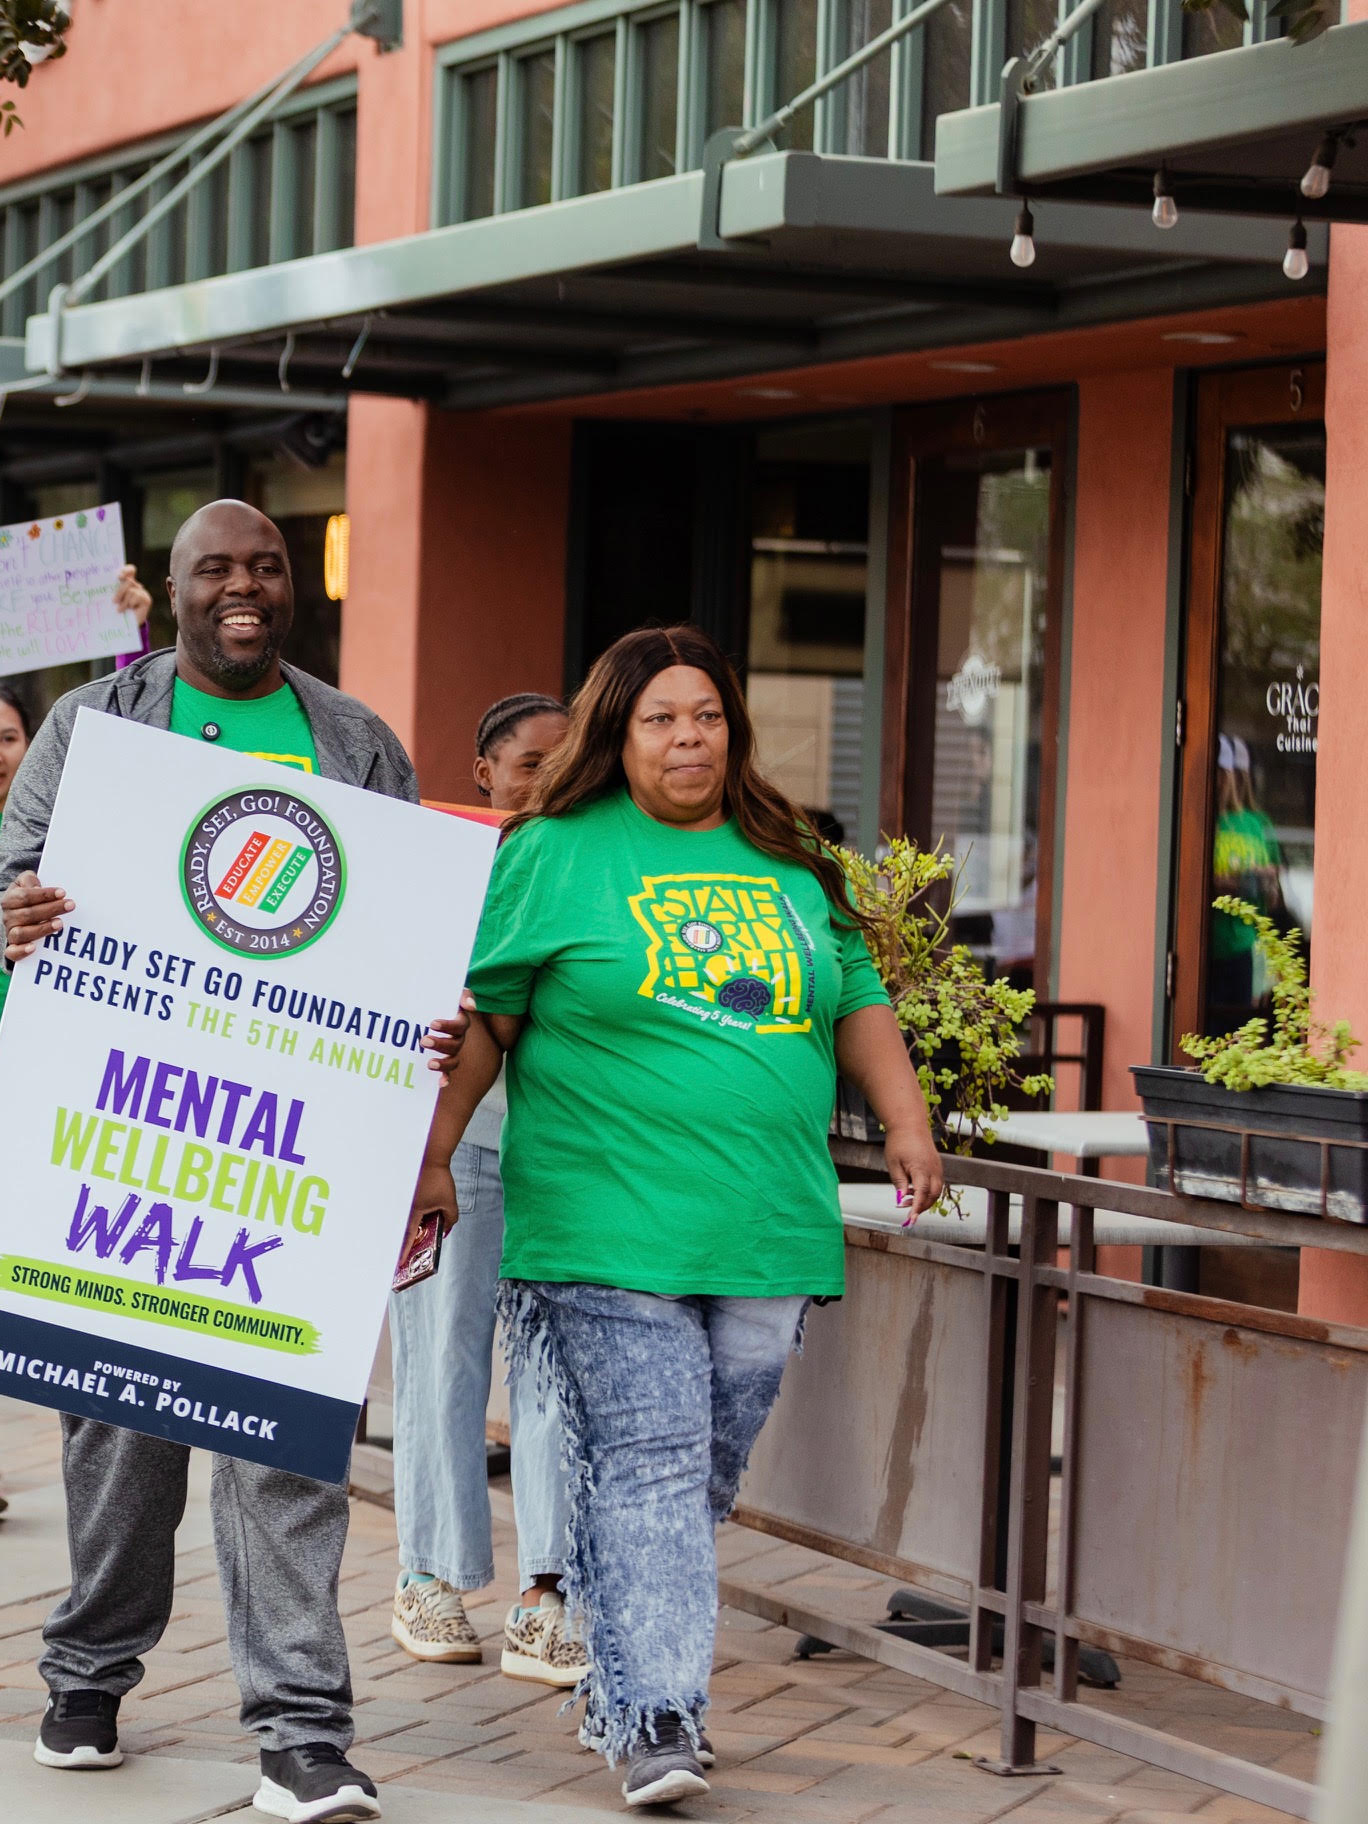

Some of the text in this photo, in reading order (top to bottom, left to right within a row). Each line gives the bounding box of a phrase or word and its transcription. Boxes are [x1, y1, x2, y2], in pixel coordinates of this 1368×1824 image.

[1289, 369, 1303, 413] 5
[58, 583, 81, 606] Be
[64, 566, 99, 589] people
[0, 621, 24, 637] the
[26, 598, 107, 635] RIGHT
[16, 637, 41, 656] will
[1286, 715, 1311, 734] Thai
[191, 795, 336, 930] READY, SET, GO! FOUNDATION
[222, 837, 263, 894] EDUCATE
[242, 842, 288, 904] EMPOWER
[266, 852, 307, 907] EXECUTE
[215, 920, 291, 950] EST 2014
[43, 926, 431, 1055] READY SET GO FOUNDATION
[656, 992, 752, 1031] Celebrating 5 Years!
[805, 970, 816, 1013] MENTAL
[34, 959, 416, 1089] PRESENTS THE 5TH ANNUAL
[95, 1048, 306, 1166] MENTAL
[50, 1106, 331, 1236] WELLBEING
[65, 1183, 284, 1304] WALK
[11, 1265, 306, 1346] STRONG MINDS. STRONGER COMMUNITY.
[93, 1360, 182, 1393] POWERED BY
[119, 1382, 146, 1408] A.
[156, 1394, 279, 1441] POLLACK
